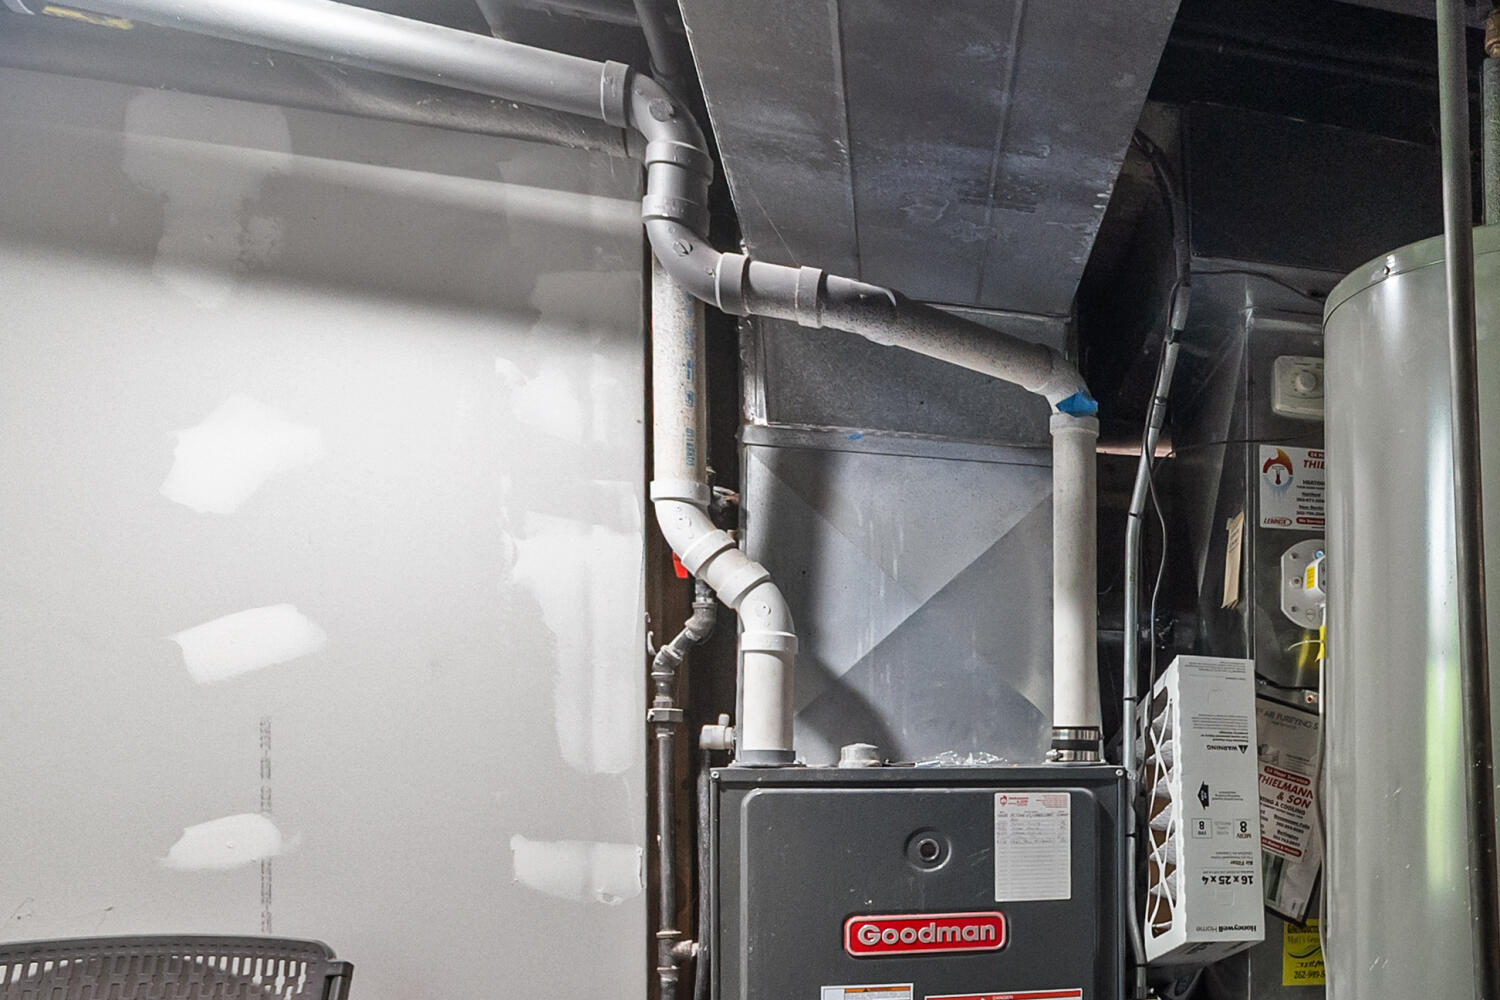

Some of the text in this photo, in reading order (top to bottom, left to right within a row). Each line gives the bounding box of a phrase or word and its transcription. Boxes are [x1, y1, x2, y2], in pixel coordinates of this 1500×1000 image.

[1287, 795, 1312, 808] SON
[1199, 821, 1205, 830] 8
[1240, 821, 1247, 832] 8
[1201, 875, 1209, 885] 4
[1218, 875, 1232, 885] 25
[1241, 875, 1254, 885] 16
[1218, 924, 1257, 933] Honeywell
[857, 922, 996, 946] Goodman
